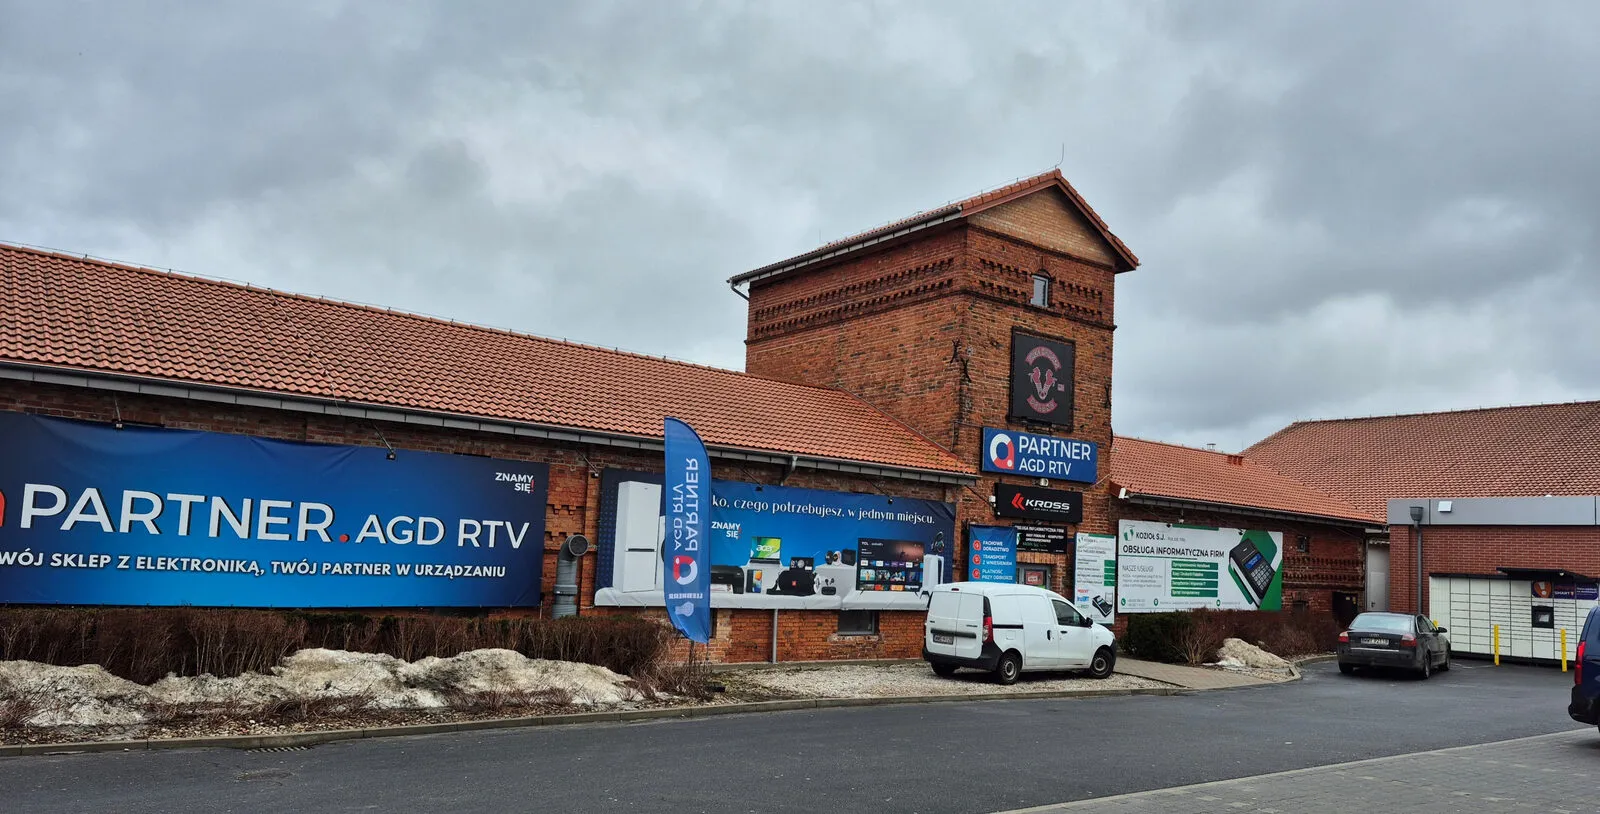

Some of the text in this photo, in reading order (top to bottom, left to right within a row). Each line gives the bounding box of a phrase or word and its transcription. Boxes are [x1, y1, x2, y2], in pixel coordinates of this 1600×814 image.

[1019, 436, 1091, 460] PARTNER
[1019, 458, 1072, 475] AGD RTV
[495, 472, 534, 483] ZNAMY
[734, 500, 768, 512] czego
[848, 508, 856, 517] w
[858, 508, 894, 520] jednym
[897, 512, 935, 524] miejscu.
[1025, 500, 1070, 510] KROSS
[355, 514, 444, 546] AGD
[457, 518, 530, 549] RTV
[712, 521, 740, 530] ZNAMY
[1123, 545, 1154, 554] OBSŁUGA
[1156, 546, 1209, 557] INFORMATYCZNA
[0, 548, 506, 579] WÓJ SKLEP Z ELEKTRONIKĄ, TWÓJ PARTNER W URZĄDZANIU
